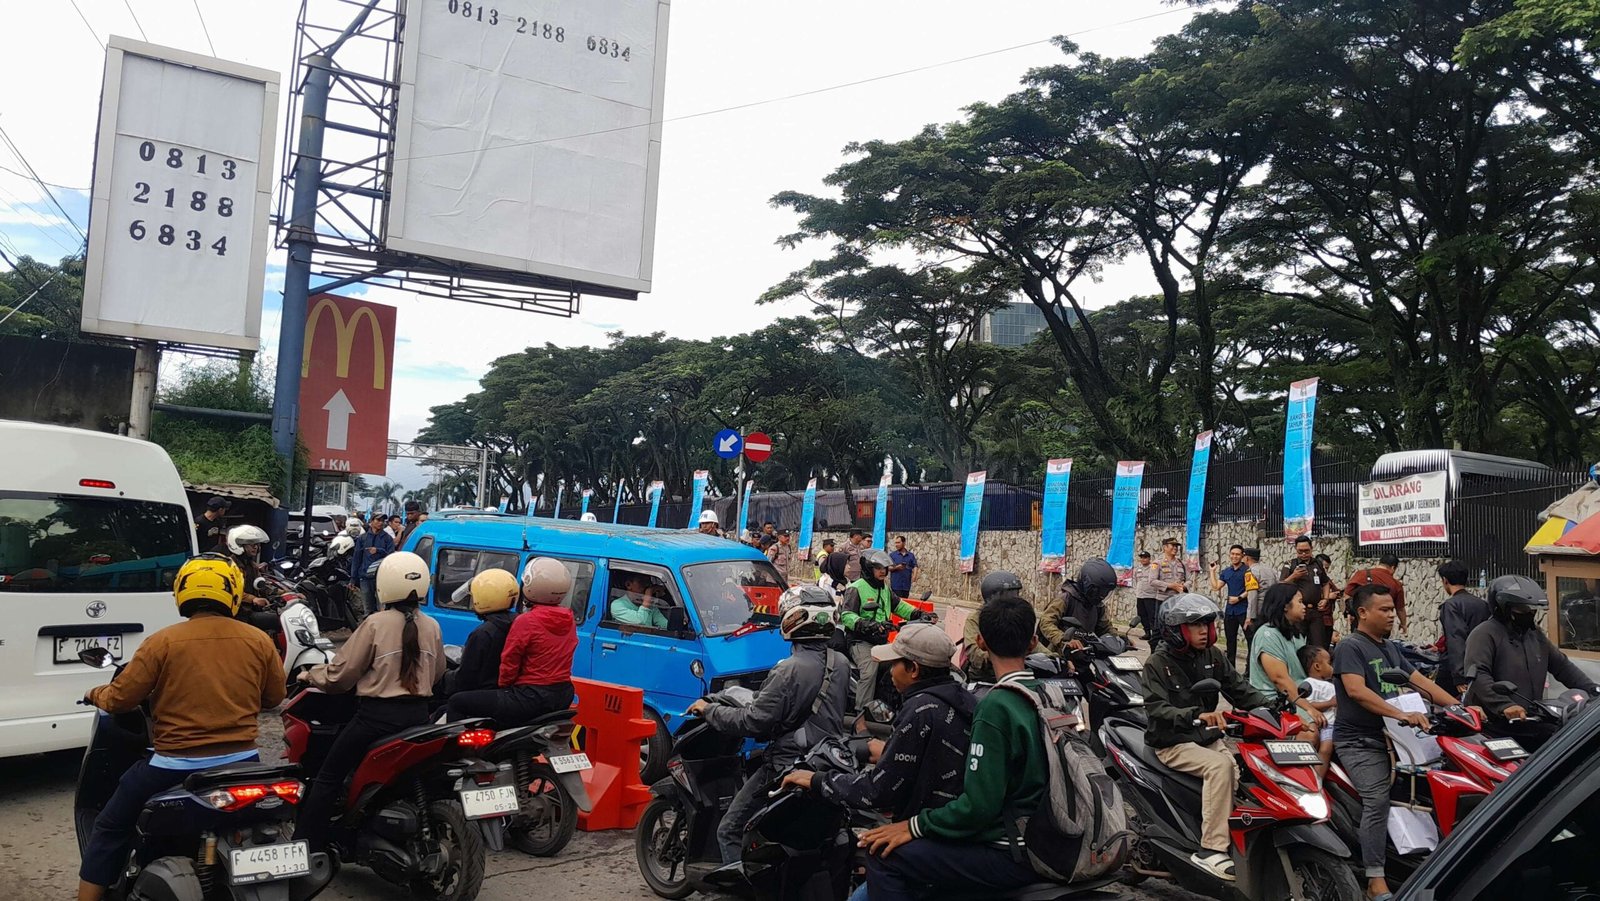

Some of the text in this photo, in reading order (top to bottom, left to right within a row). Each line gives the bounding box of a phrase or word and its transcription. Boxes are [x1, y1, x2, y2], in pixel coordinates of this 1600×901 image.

[448, 0, 631, 63] 0813 2188 6834
[139, 141, 237, 180] 0813
[133, 182, 234, 218] 2188
[129, 219, 227, 256] 6834
[319, 458, 350, 471] 1 KM
[1374, 482, 1421, 500] DILARANG
[107, 637, 120, 650] FZ
[894, 753, 917, 763] BOOM
[970, 742, 984, 757] NO
[970, 758, 979, 771] 3
[464, 787, 515, 804] F 4750 FJN
[1267, 796, 1288, 811] HONDA
[234, 845, 305, 866] F 4458 FFK
